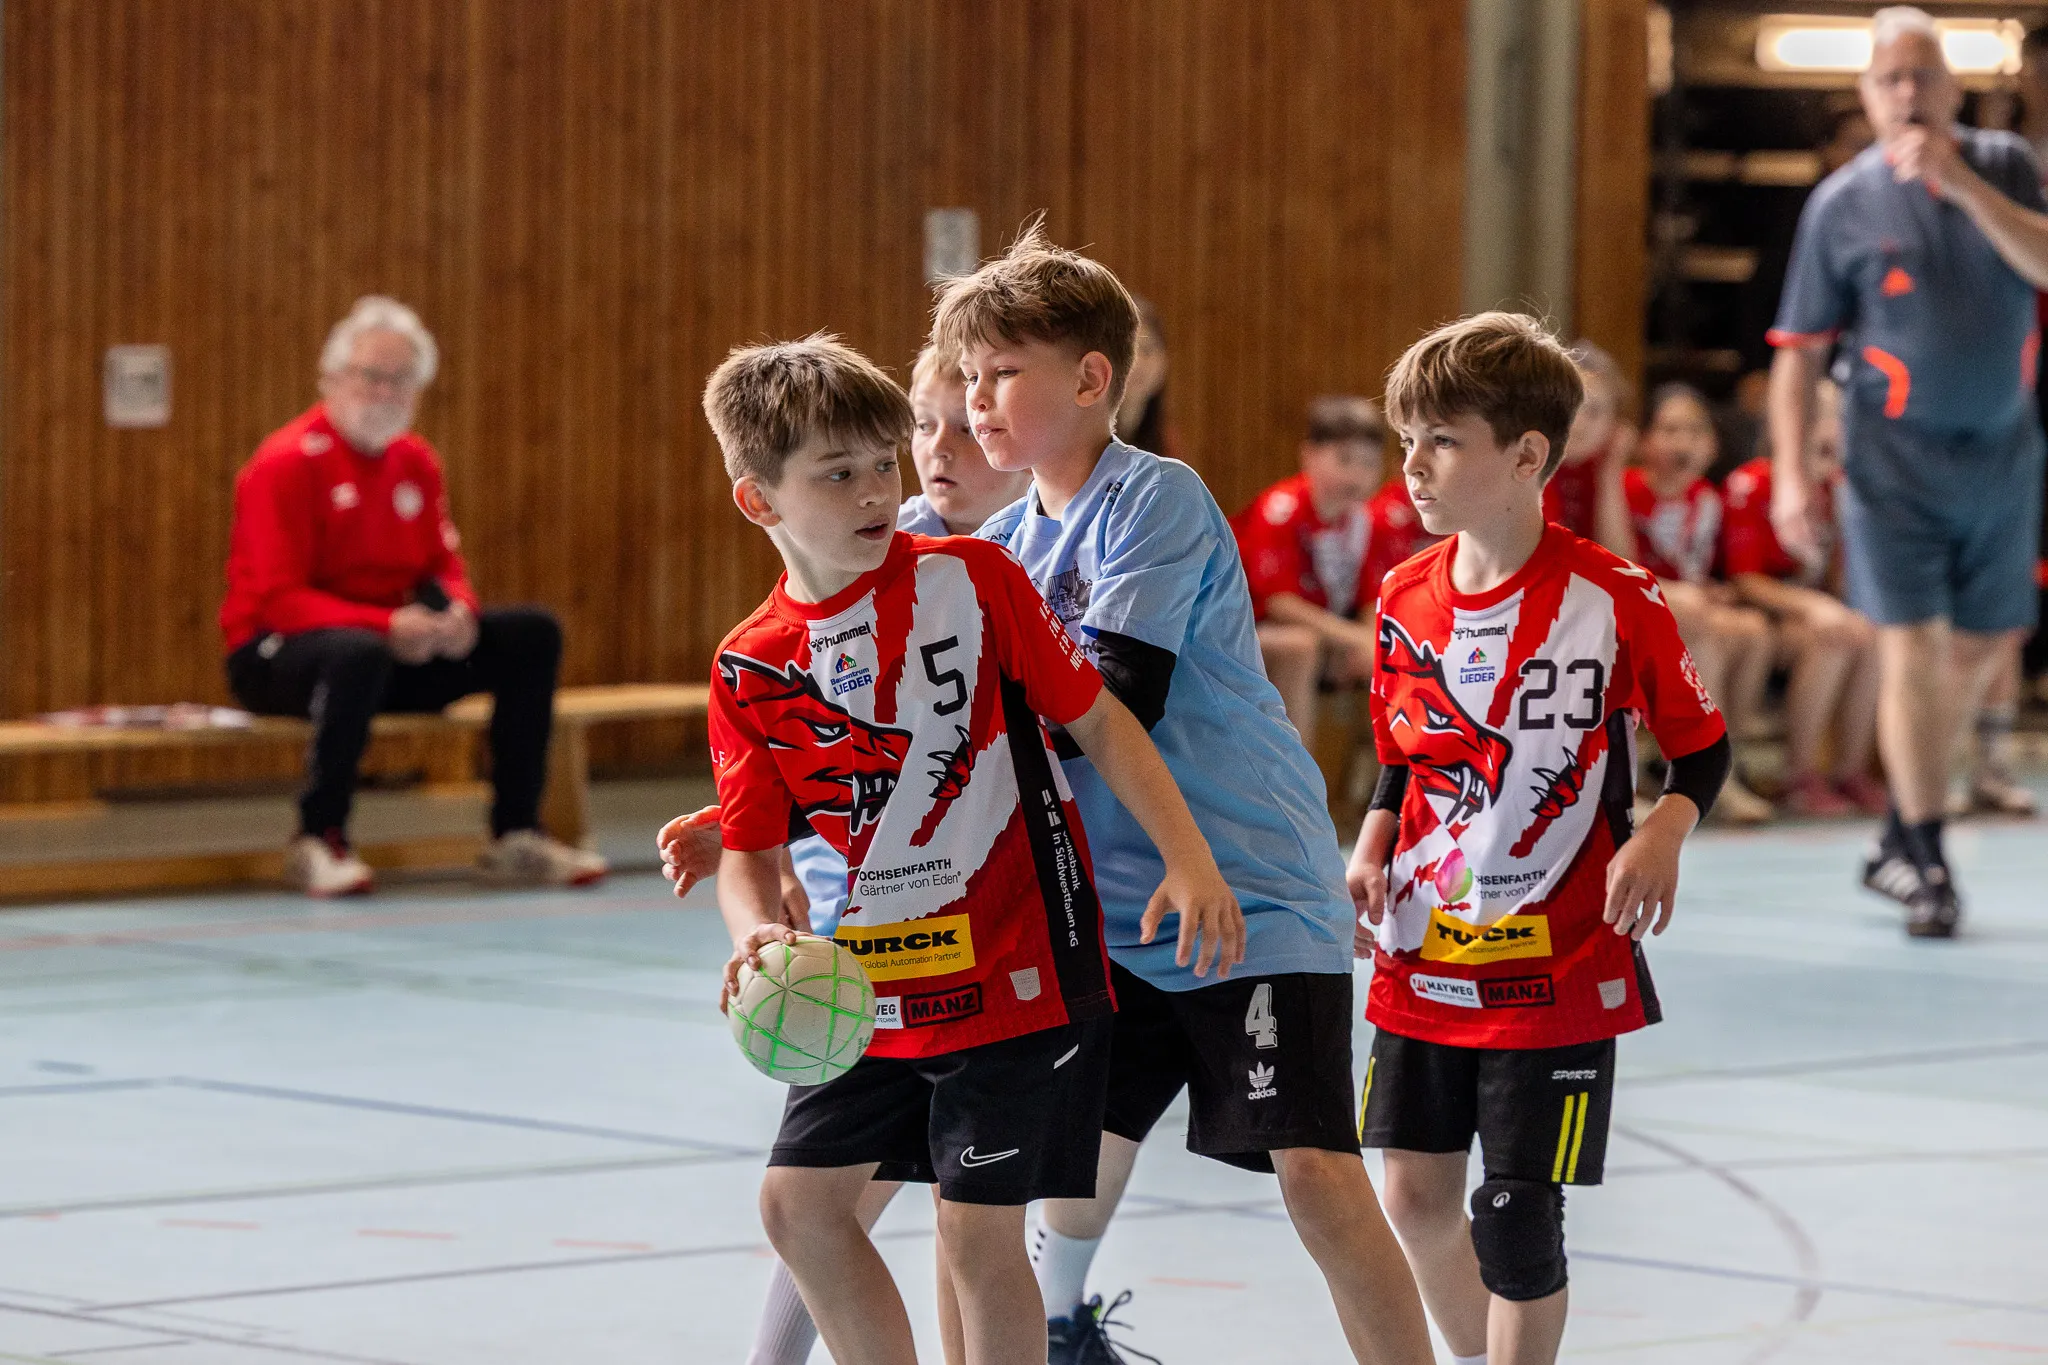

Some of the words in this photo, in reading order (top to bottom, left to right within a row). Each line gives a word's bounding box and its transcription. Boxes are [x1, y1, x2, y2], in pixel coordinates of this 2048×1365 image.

[824, 621, 872, 648] hummel
[1466, 623, 1508, 639] hummel
[830, 667, 870, 686] Bauzentrum
[833, 673, 873, 696] LIEDER
[918, 634, 968, 717] 5
[1460, 672, 1495, 684] LIEDER
[1519, 658, 1605, 731] 23
[1052, 832, 1061, 845] in
[859, 858, 952, 881] OCHSENFARTH
[860, 882, 905, 896] Gärtner
[908, 878, 930, 889] von
[1055, 847, 1076, 928] Südwestfalen
[1069, 930, 1079, 947] eG
[1436, 922, 1536, 946] TUCK
[864, 959, 889, 969] Global
[890, 954, 932, 967] Automation
[934, 951, 962, 962] Partner
[1427, 980, 1474, 996] MAYWEG
[1487, 983, 1548, 1001] MANZ
[910, 992, 977, 1020] MANZ
[1245, 983, 1278, 1050] 4
[1551, 1069, 1598, 1080] SPORTS
[1248, 1087, 1277, 1100] adidas
